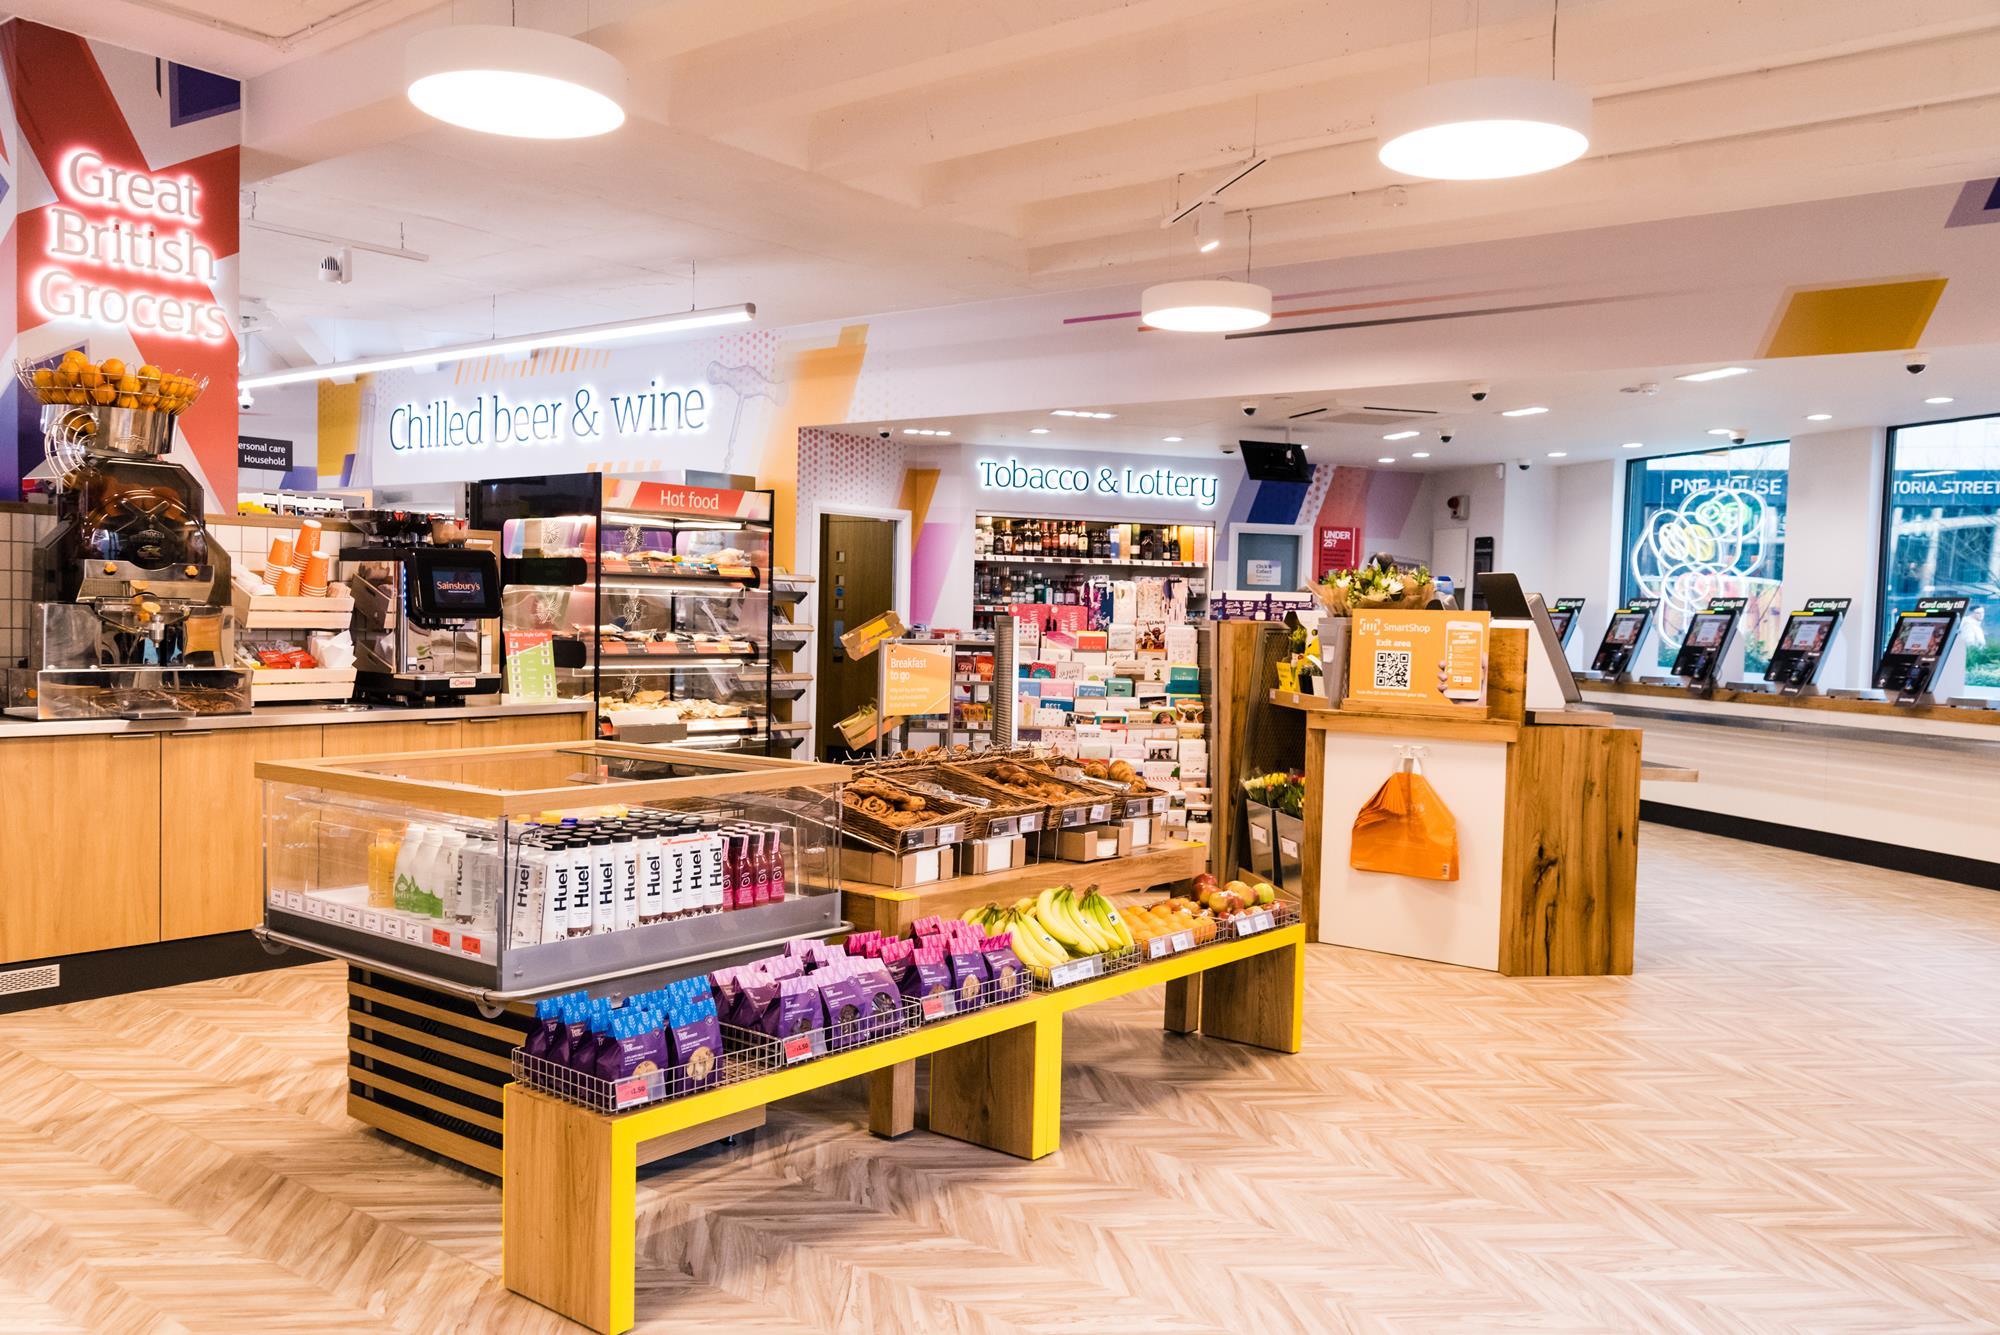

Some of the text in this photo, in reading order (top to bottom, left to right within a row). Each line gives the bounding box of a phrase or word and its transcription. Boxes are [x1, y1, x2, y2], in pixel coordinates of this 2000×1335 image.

[69, 151, 202, 220] Great
[51, 207, 217, 281] British
[39, 270, 229, 340] Grocers
[389, 380, 705, 451] Chilled beer & wine
[238, 443, 286, 454] ersonal care
[244, 454, 286, 466] Household
[660, 490, 719, 510] Hot food
[980, 459, 1219, 506] Tobacco & Lottery
[1893, 480, 1937, 495] TORIA
[1323, 530, 1351, 540] UNDER
[1323, 539, 1337, 548] 25?
[436, 581, 481, 592] Sainsbury's
[1376, 639, 1392, 647] Exit
[1383, 624, 1430, 633] SmartShop
[890, 657, 927, 669] Breakfast
[890, 671, 910, 683] to go
[574, 865, 589, 908] Huel
[600, 862, 613, 905] Huel
[624, 859, 636, 901] Huel
[647, 856, 660, 897] Huel
[672, 853, 683, 894] Huel
[690, 850, 702, 890] Huel
[709, 847, 722, 887] Huel
[554, 868, 568, 912] Huel
